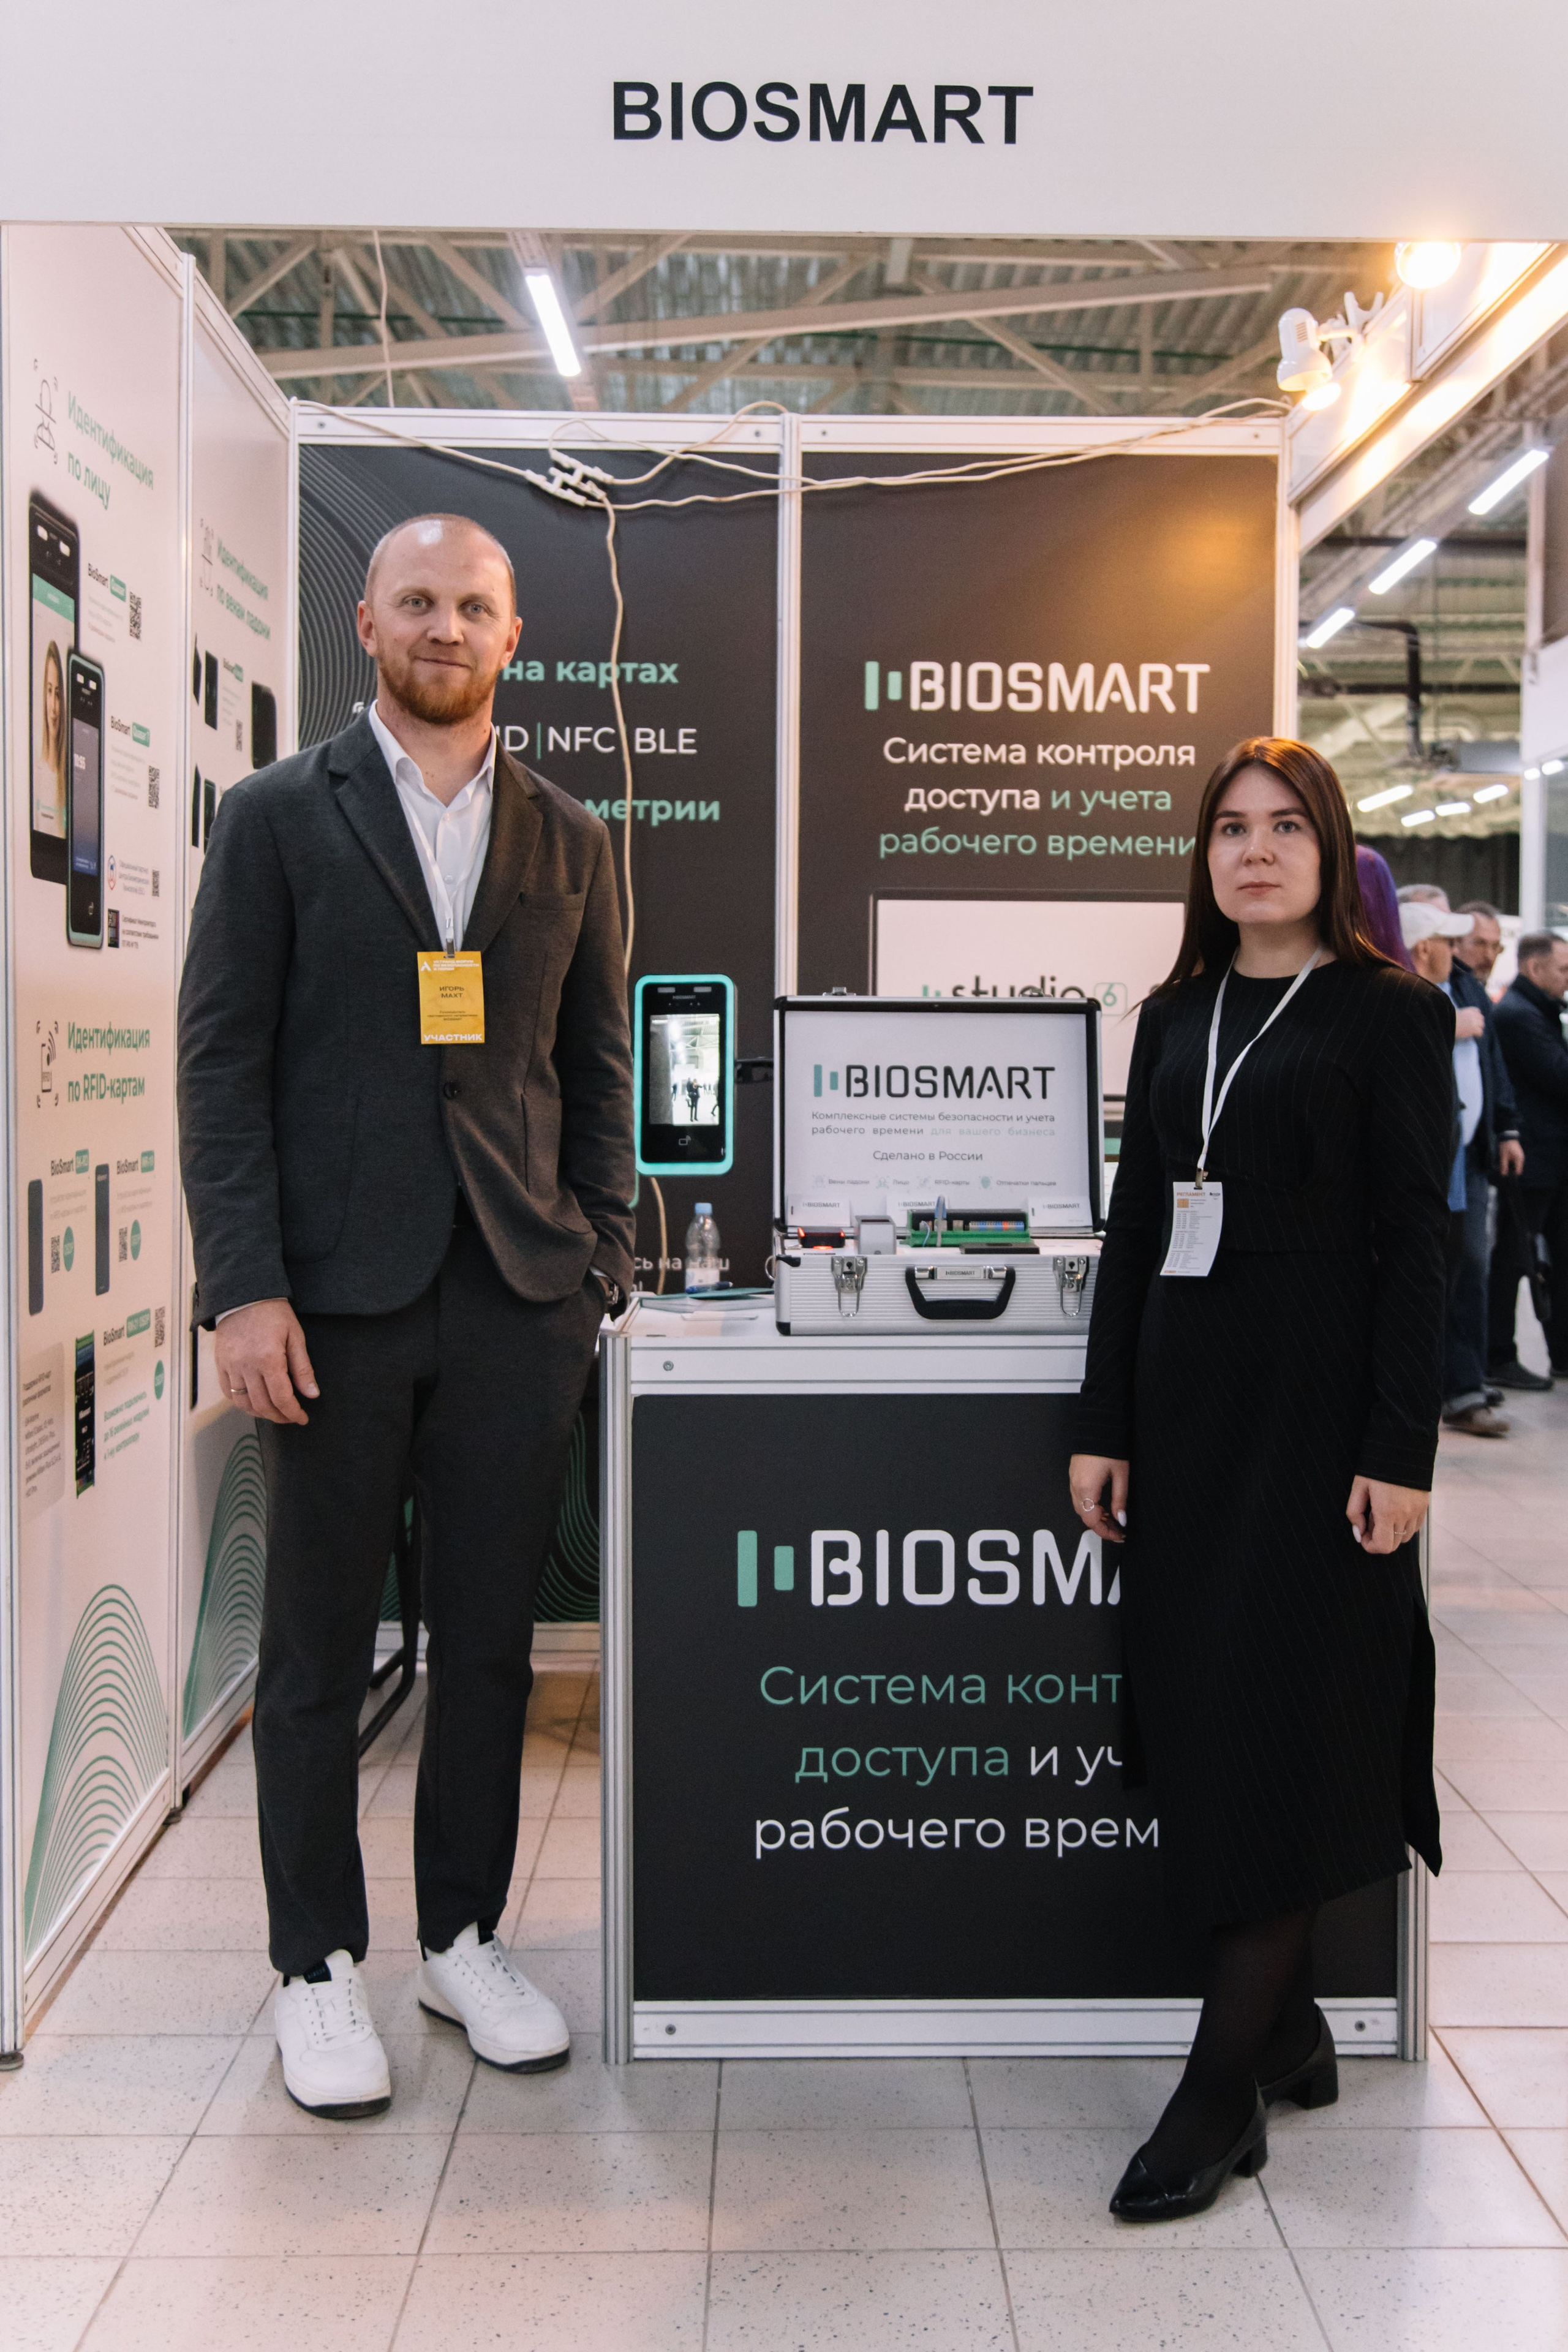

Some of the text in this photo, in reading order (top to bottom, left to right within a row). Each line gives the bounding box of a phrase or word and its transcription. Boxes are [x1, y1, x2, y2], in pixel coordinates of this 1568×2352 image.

[613, 81, 1033, 144] BIOSMART
[69, 390, 153, 491] Идентификация
[68, 451, 110, 511] по лицу
[503, 661, 679, 688] на картах
[910, 662, 1210, 713] BIOSMART
[548, 726, 616, 753] NFC
[635, 728, 697, 753] BLE
[884, 737, 1196, 771] Система контроля
[905, 788, 1172, 816] доступа и учета
[880, 827, 1196, 860] рабочего времени
[1102, 982, 1117, 1006] 6
[67, 1022, 150, 1055] Идентификация
[68, 1072, 145, 1104] по RFID-картам
[846, 1065, 1055, 1099] BIOSMART
[812, 1112, 886, 1120] Комплексные
[938, 1112, 1013, 1121] безопасности
[1025, 1114, 1055, 1123] учета
[812, 1125, 865, 1136] рабочего
[873, 1128, 924, 1136] времени
[1008, 1127, 1055, 1136] бизнеса
[51, 1158, 74, 1176] BioSmart
[116, 1158, 138, 1175] BioSmart
[873, 1151, 925, 1161] Сделано
[939, 1151, 983, 1161] России
[104, 1325, 124, 1346] BioSmart
[760, 1666, 1123, 1705] Система конт
[795, 1746, 1009, 1786] доступа
[1030, 1746, 1058, 1776] и
[756, 1806, 1159, 1860] рабочего врем
